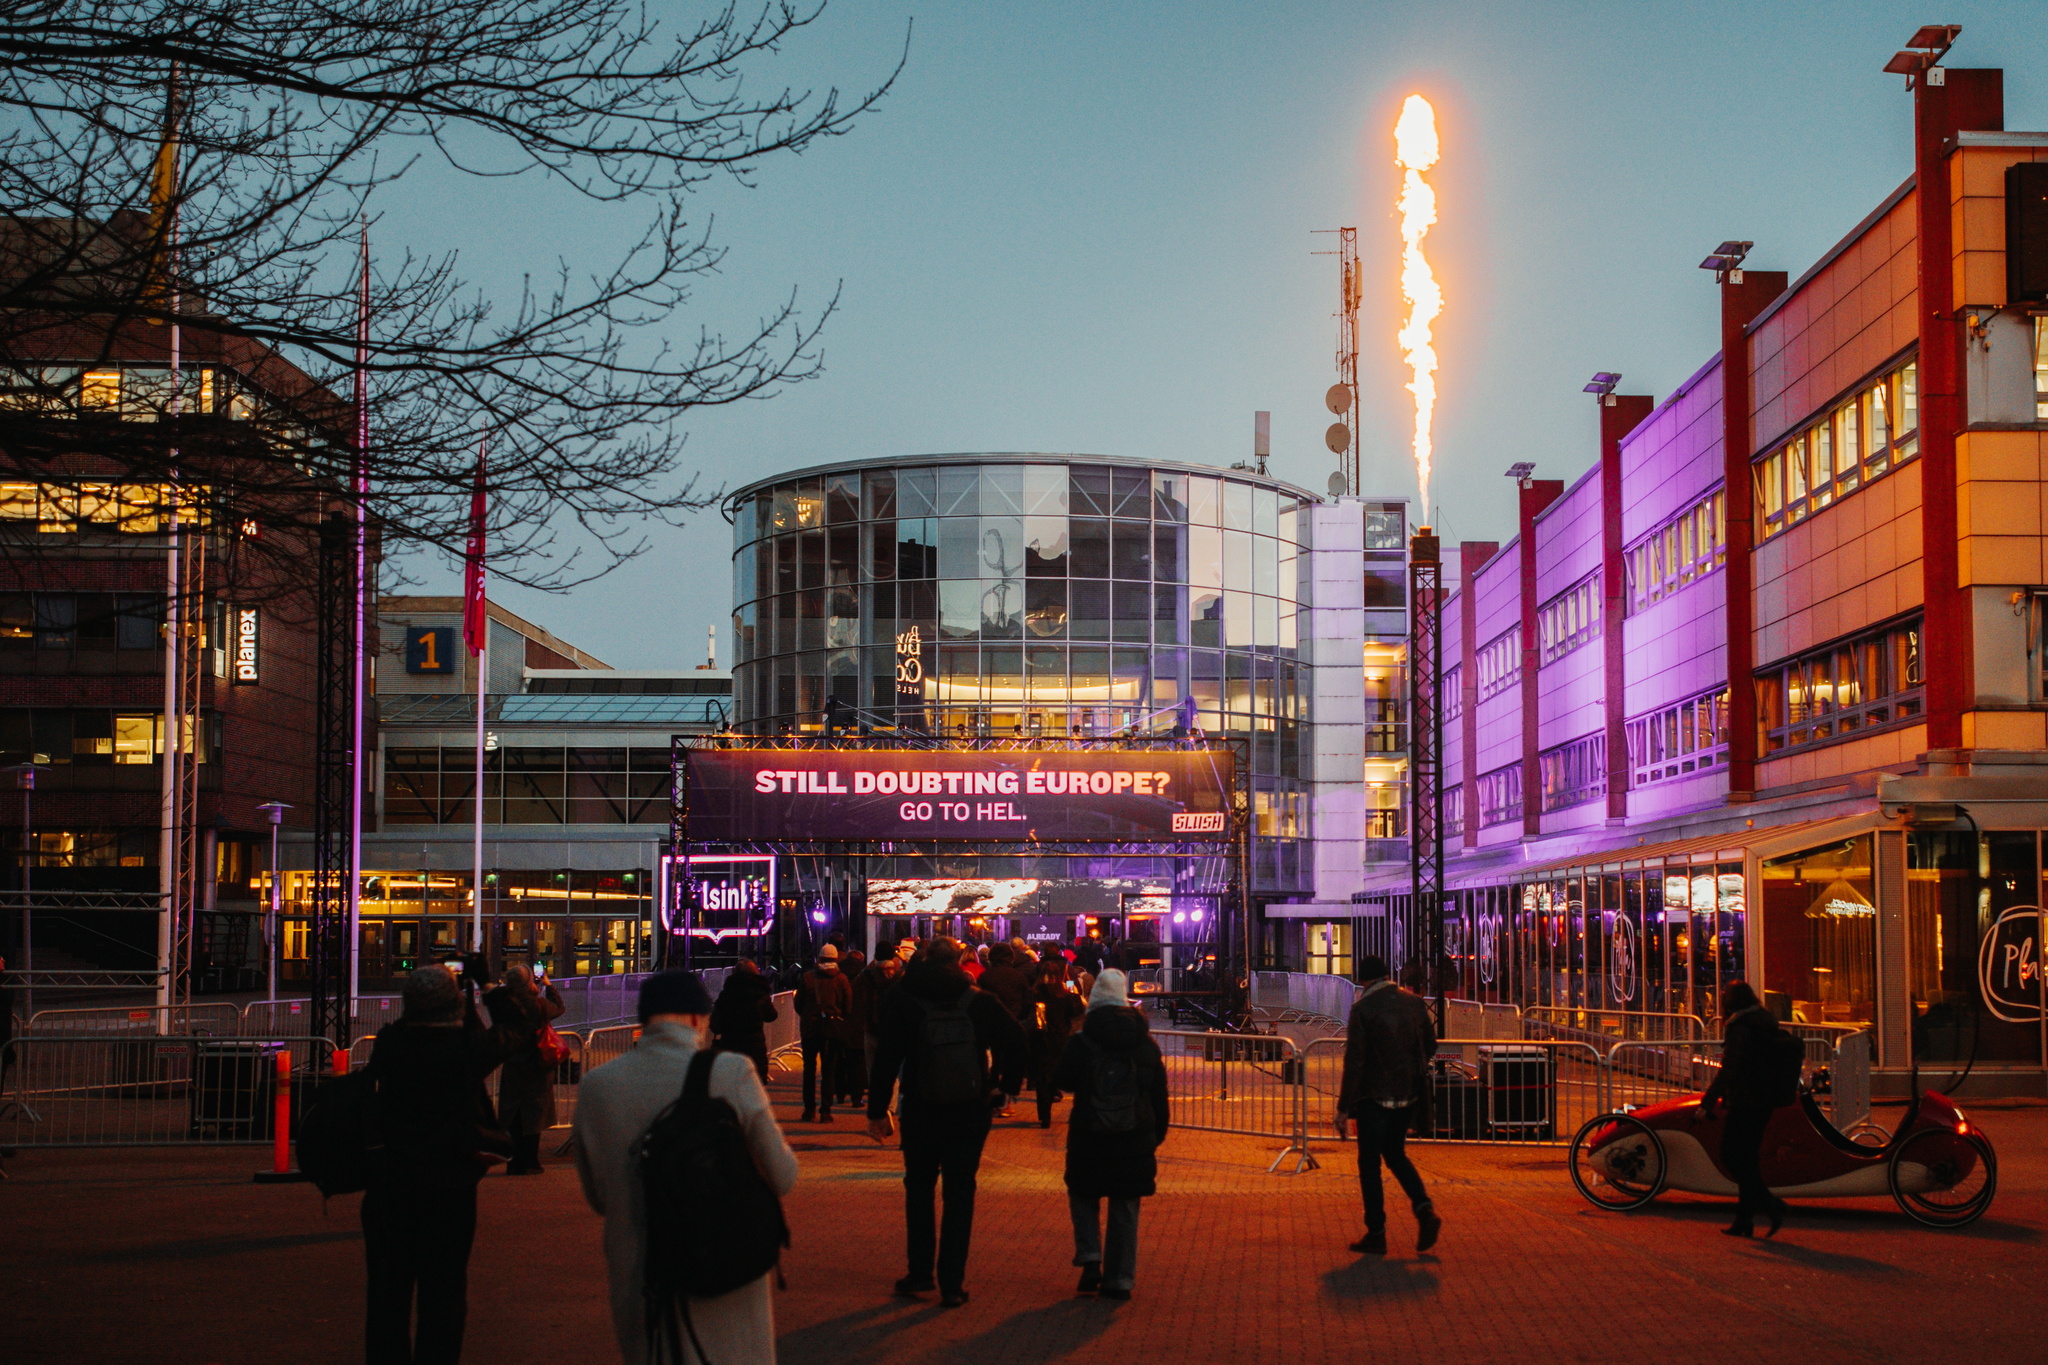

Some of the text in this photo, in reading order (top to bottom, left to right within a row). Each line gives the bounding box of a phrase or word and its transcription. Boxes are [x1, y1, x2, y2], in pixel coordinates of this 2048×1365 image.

[236, 609, 257, 681] planex
[418, 632, 440, 669] 1
[755, 770, 1171, 795] STILL DOUBTING EUROPE?
[900, 801, 1027, 821] GO TO HEL.
[1174, 815, 1222, 830] SLUSH
[1026, 933, 1061, 941] ALREADY
[2003, 937, 2048, 990] Pla
